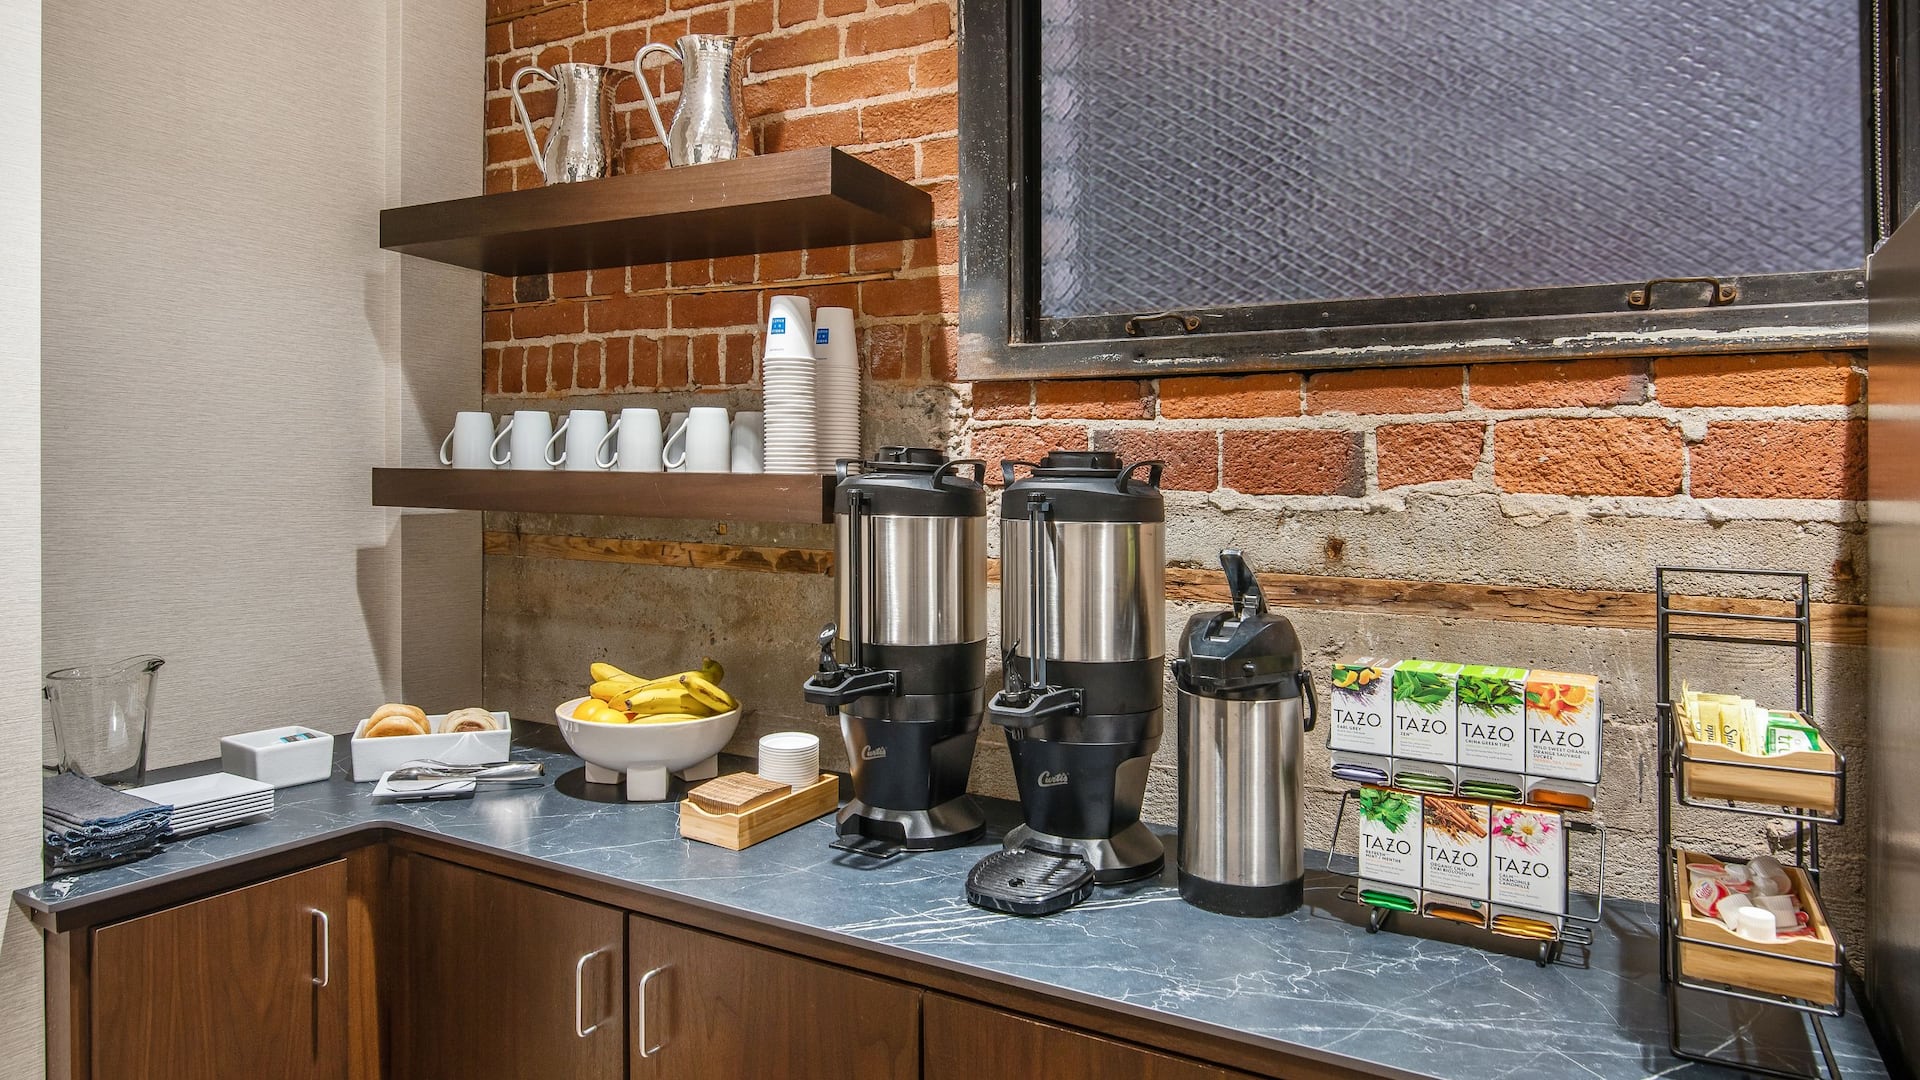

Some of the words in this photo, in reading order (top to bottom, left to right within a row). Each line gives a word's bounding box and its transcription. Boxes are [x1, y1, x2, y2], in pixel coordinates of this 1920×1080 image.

[1334, 709, 1381, 727] TAZO
[1396, 716, 1447, 734] TAZO
[1461, 722, 1514, 741] TAZO
[1529, 728, 1584, 747] TAZO
[1037, 770, 1069, 787] Curtis
[1362, 833, 1411, 854] TAZO
[1427, 845, 1478, 867] TAZO
[1494, 855, 1549, 878] TAZO
